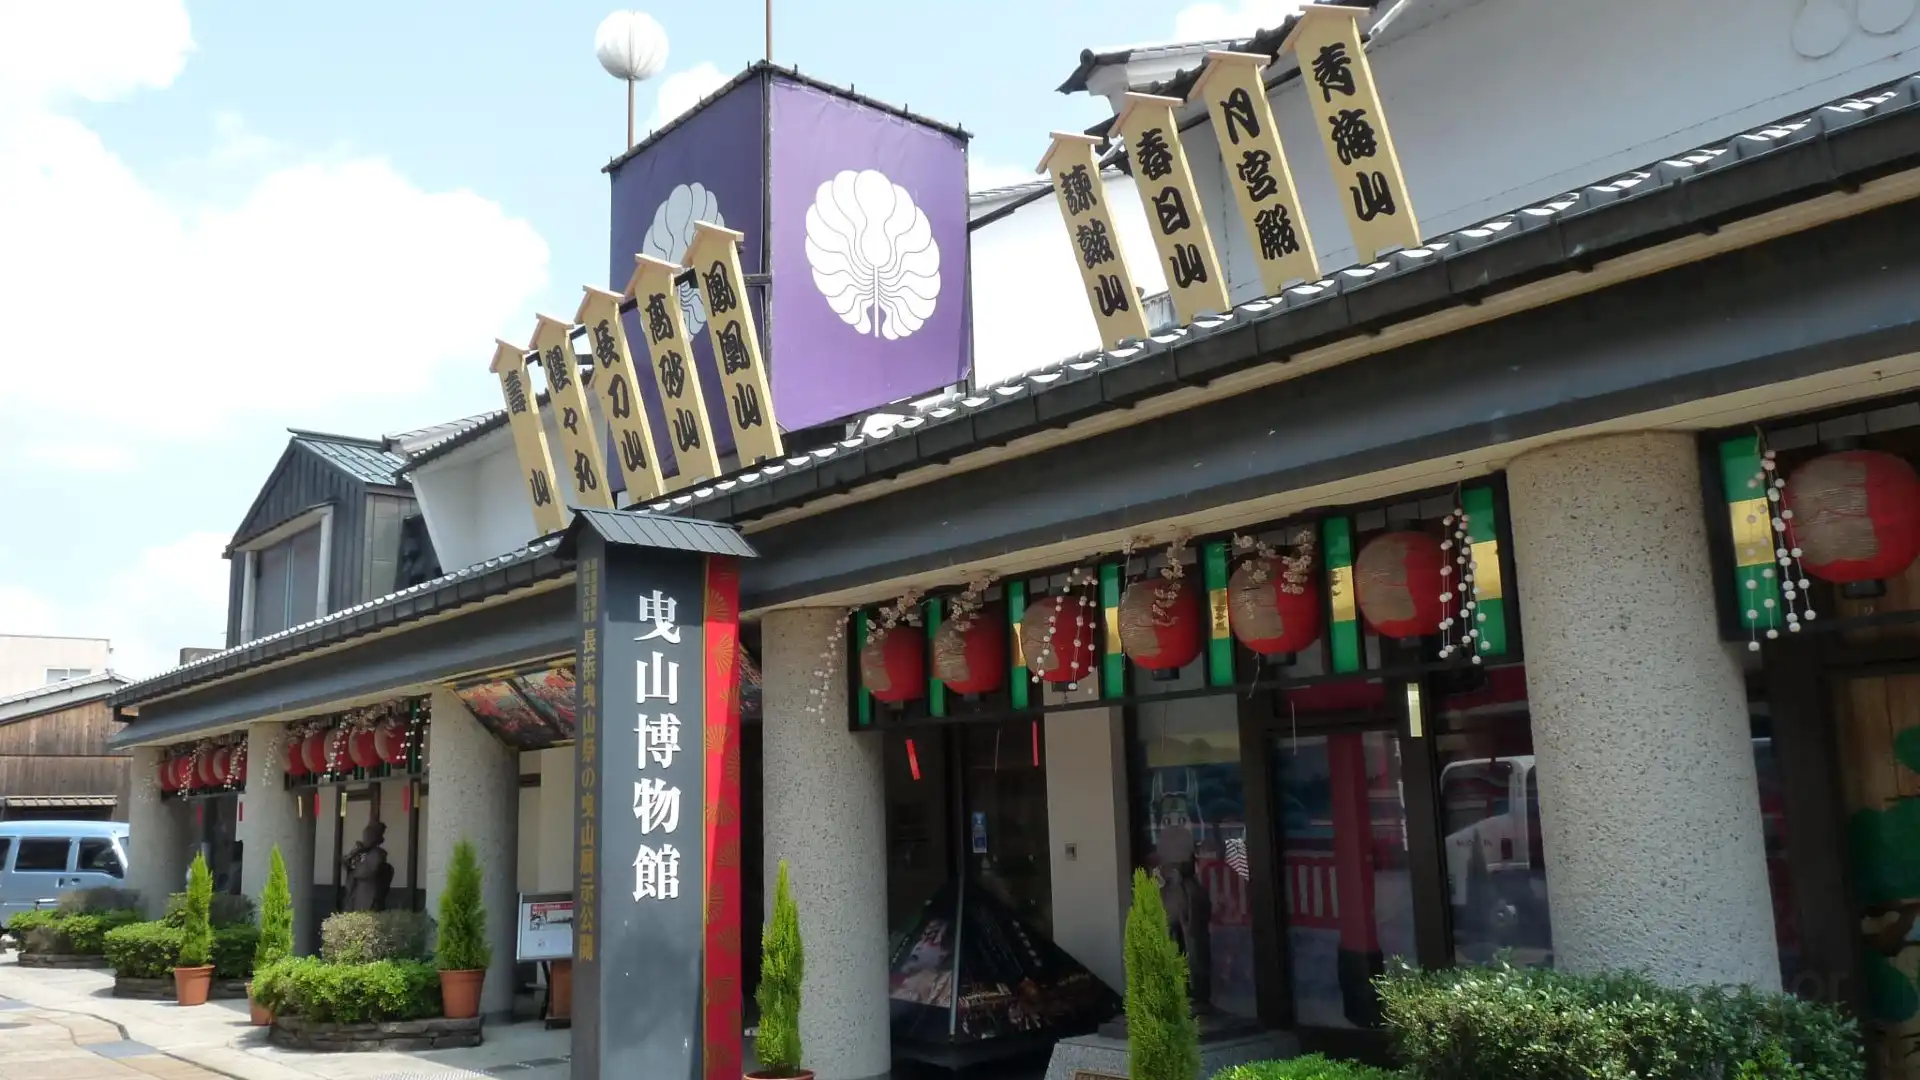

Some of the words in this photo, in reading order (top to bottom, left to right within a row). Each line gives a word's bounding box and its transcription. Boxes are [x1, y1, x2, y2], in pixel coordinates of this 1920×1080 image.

[1136, 128, 1207, 289] 春日山
[632, 589, 682, 902] 曳山博物館
